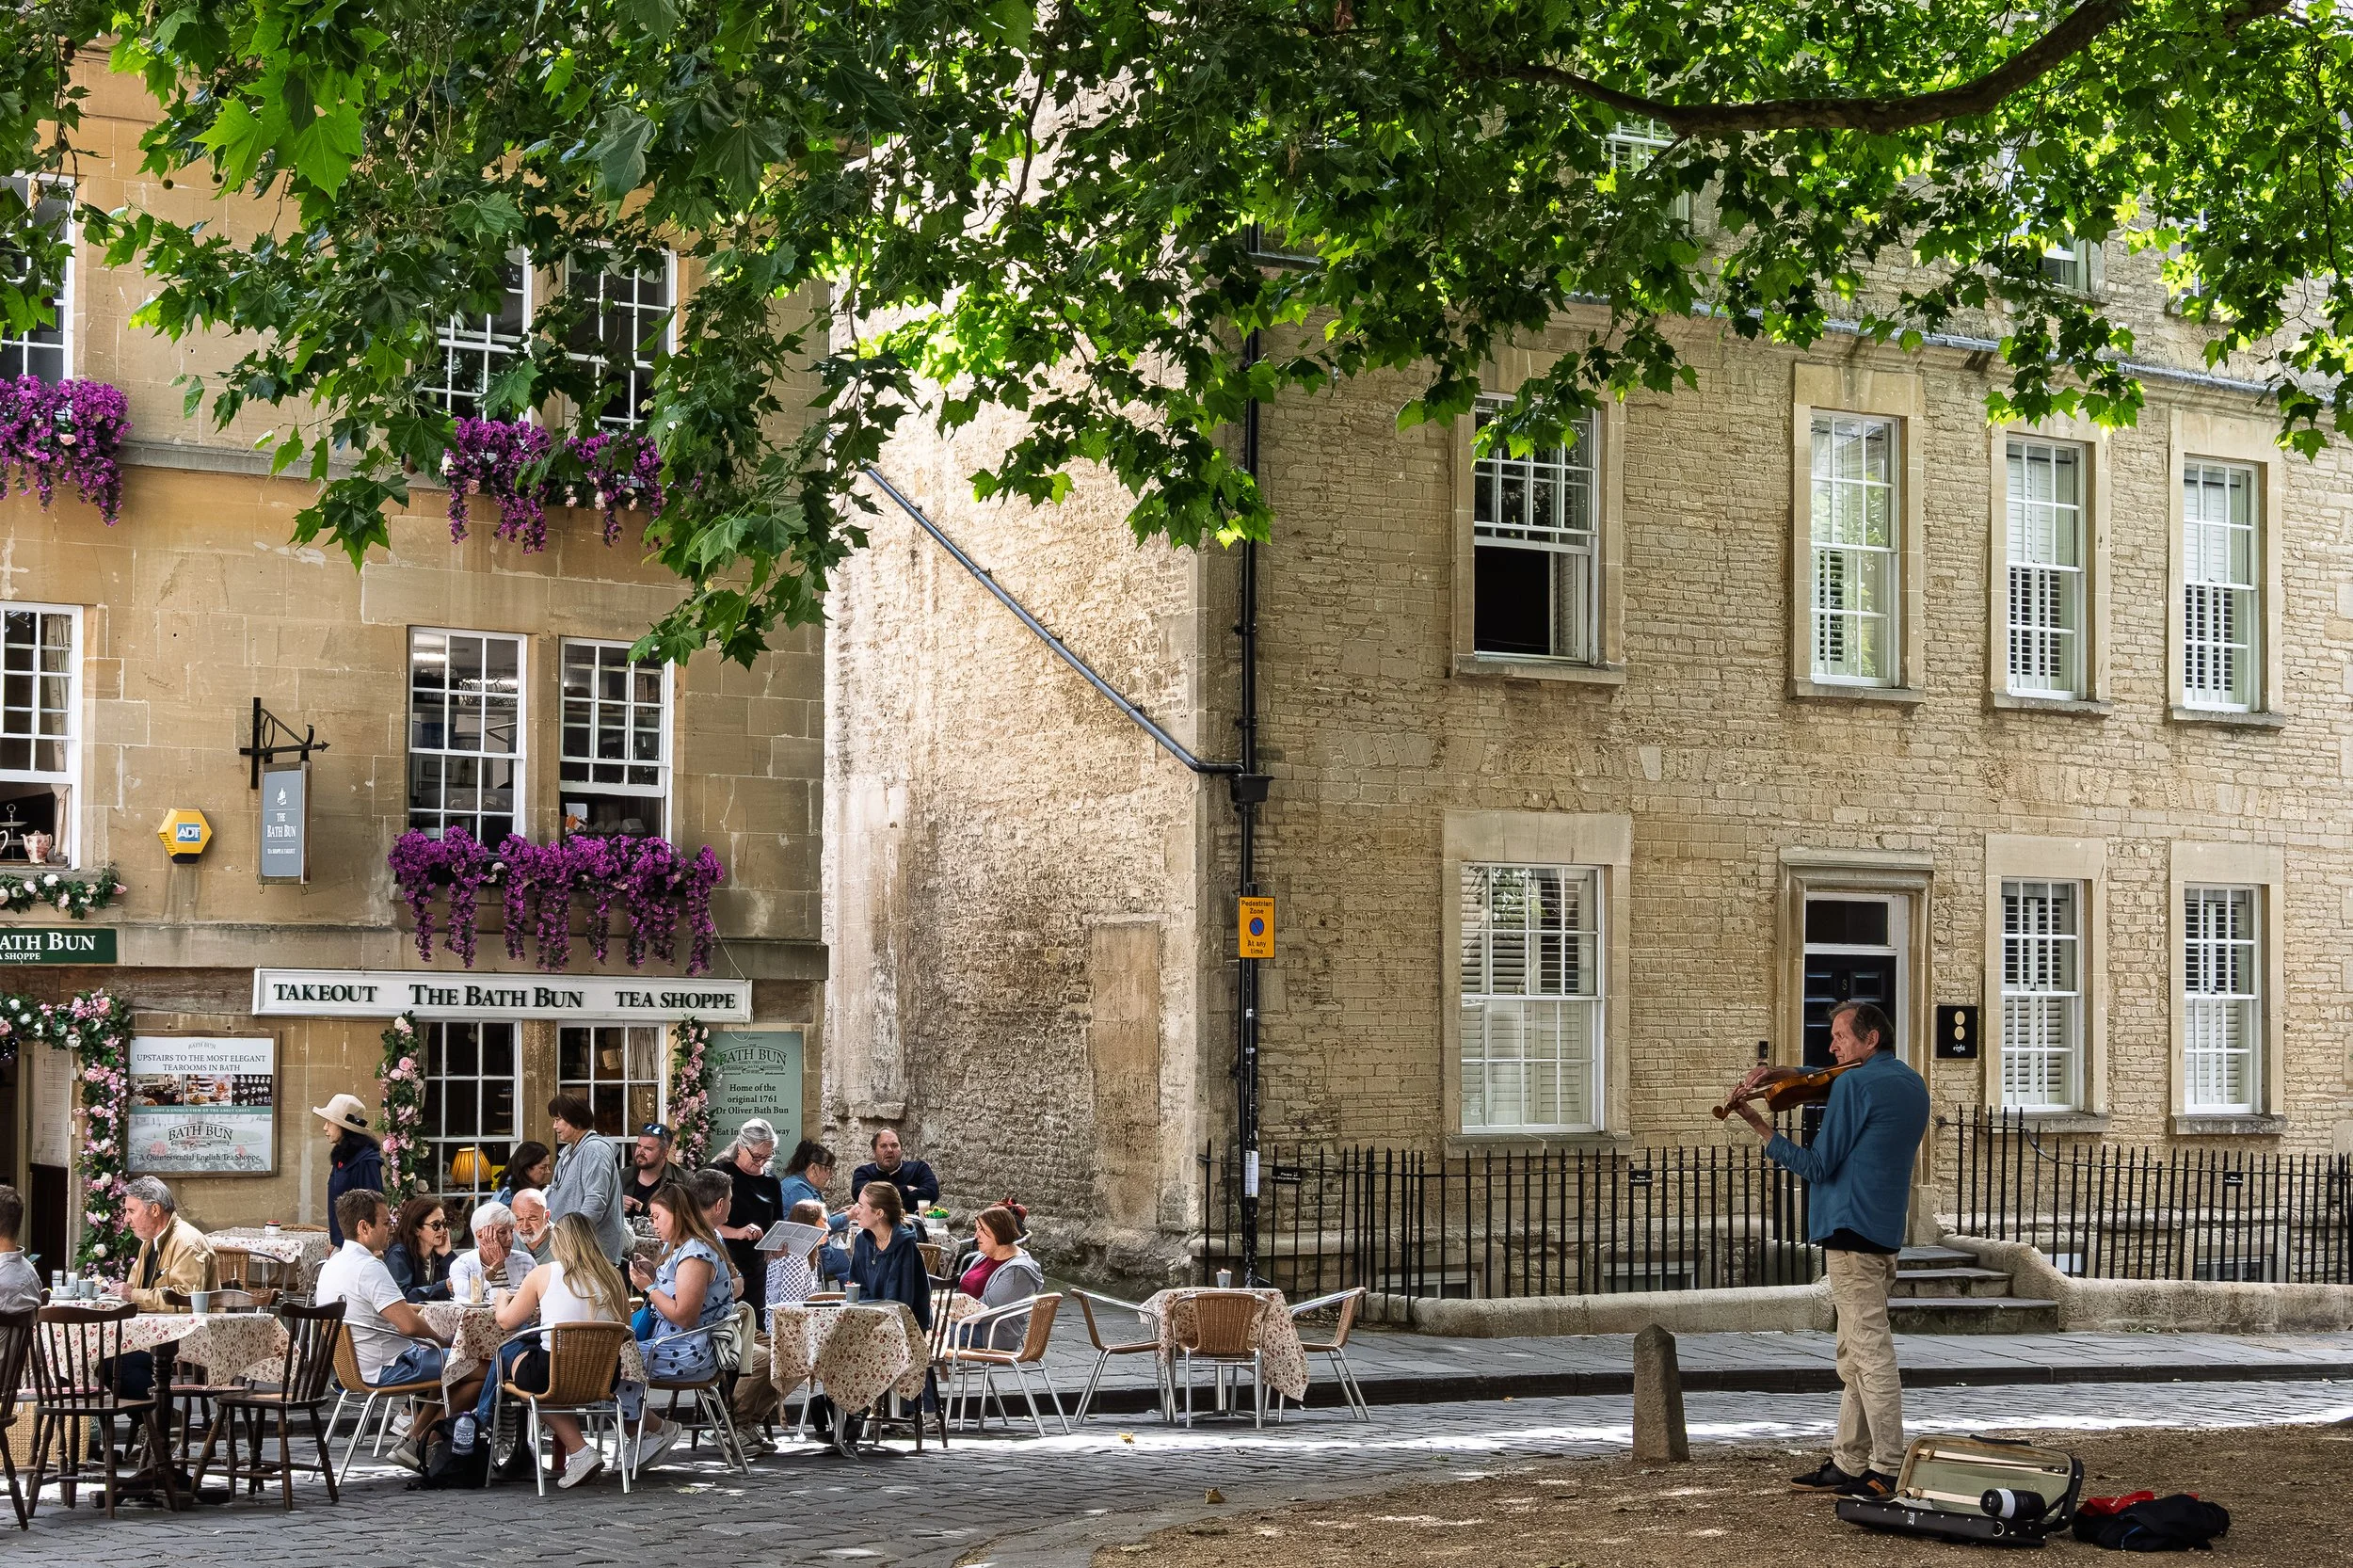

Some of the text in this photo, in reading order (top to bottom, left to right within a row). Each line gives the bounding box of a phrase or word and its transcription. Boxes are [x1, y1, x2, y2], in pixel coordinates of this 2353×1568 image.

[276, 813, 286, 822] THE
[177, 826, 201, 838] ADT
[267, 824, 296, 837] BATH BUN
[47, 932, 96, 950] BUN
[4, 952, 41, 960] SHOPPE
[273, 984, 736, 1009] TAKEOUT THE BATH BUN TEA SHOPPE
[1953, 1044, 1966, 1053] eight
[759, 1048, 787, 1066] BUN
[754, 1083, 763, 1091] of
[727, 1095, 757, 1105] original
[728, 1106, 752, 1114] Oliver
[168, 1127, 234, 1141] BATH BUN
[146, 1153, 194, 1162] Quintessential
[196, 1153, 221, 1162] English
[235, 1154, 260, 1162] Shoppe
